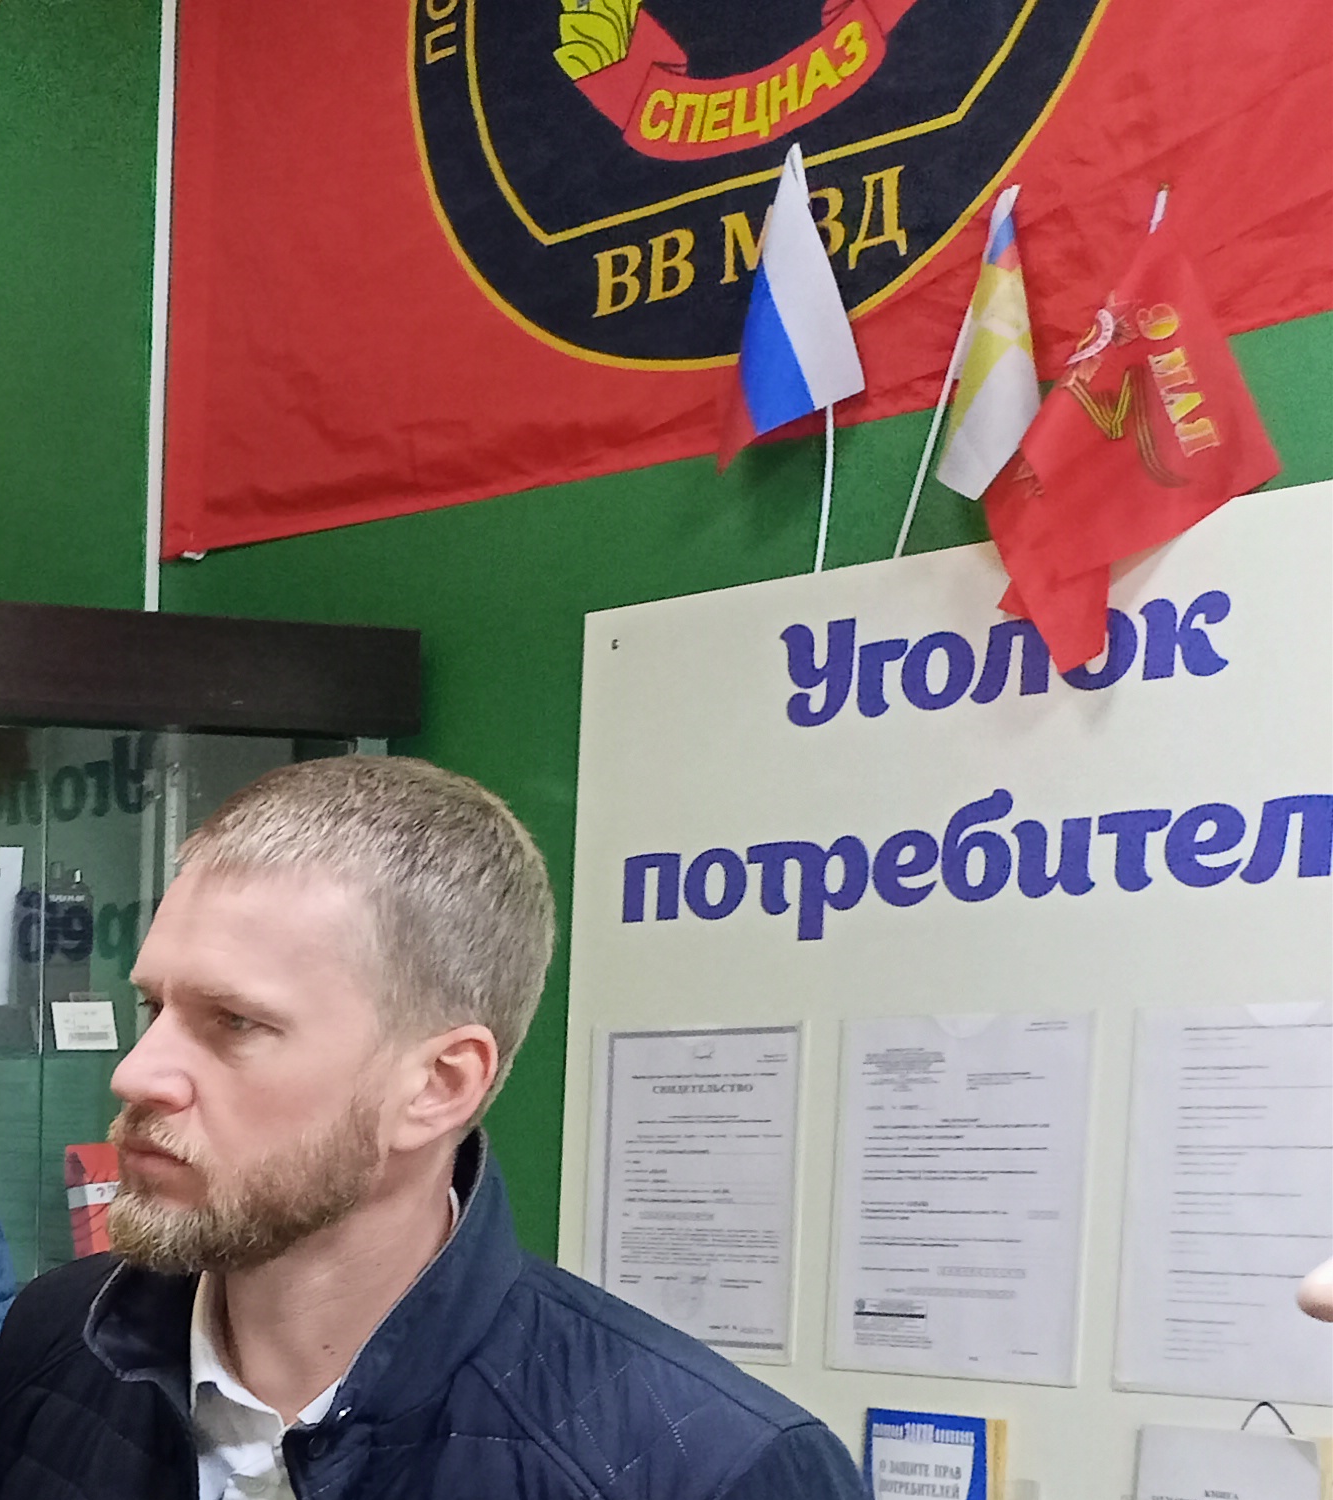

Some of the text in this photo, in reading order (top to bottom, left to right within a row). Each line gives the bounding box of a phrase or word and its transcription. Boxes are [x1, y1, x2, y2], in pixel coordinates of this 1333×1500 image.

[640, 21, 869, 143] СПЕЦНАЗ
[591, 227, 696, 319] ВВ
[1136, 303, 1180, 341] 9
[621, 787, 1333, 942] потребител
